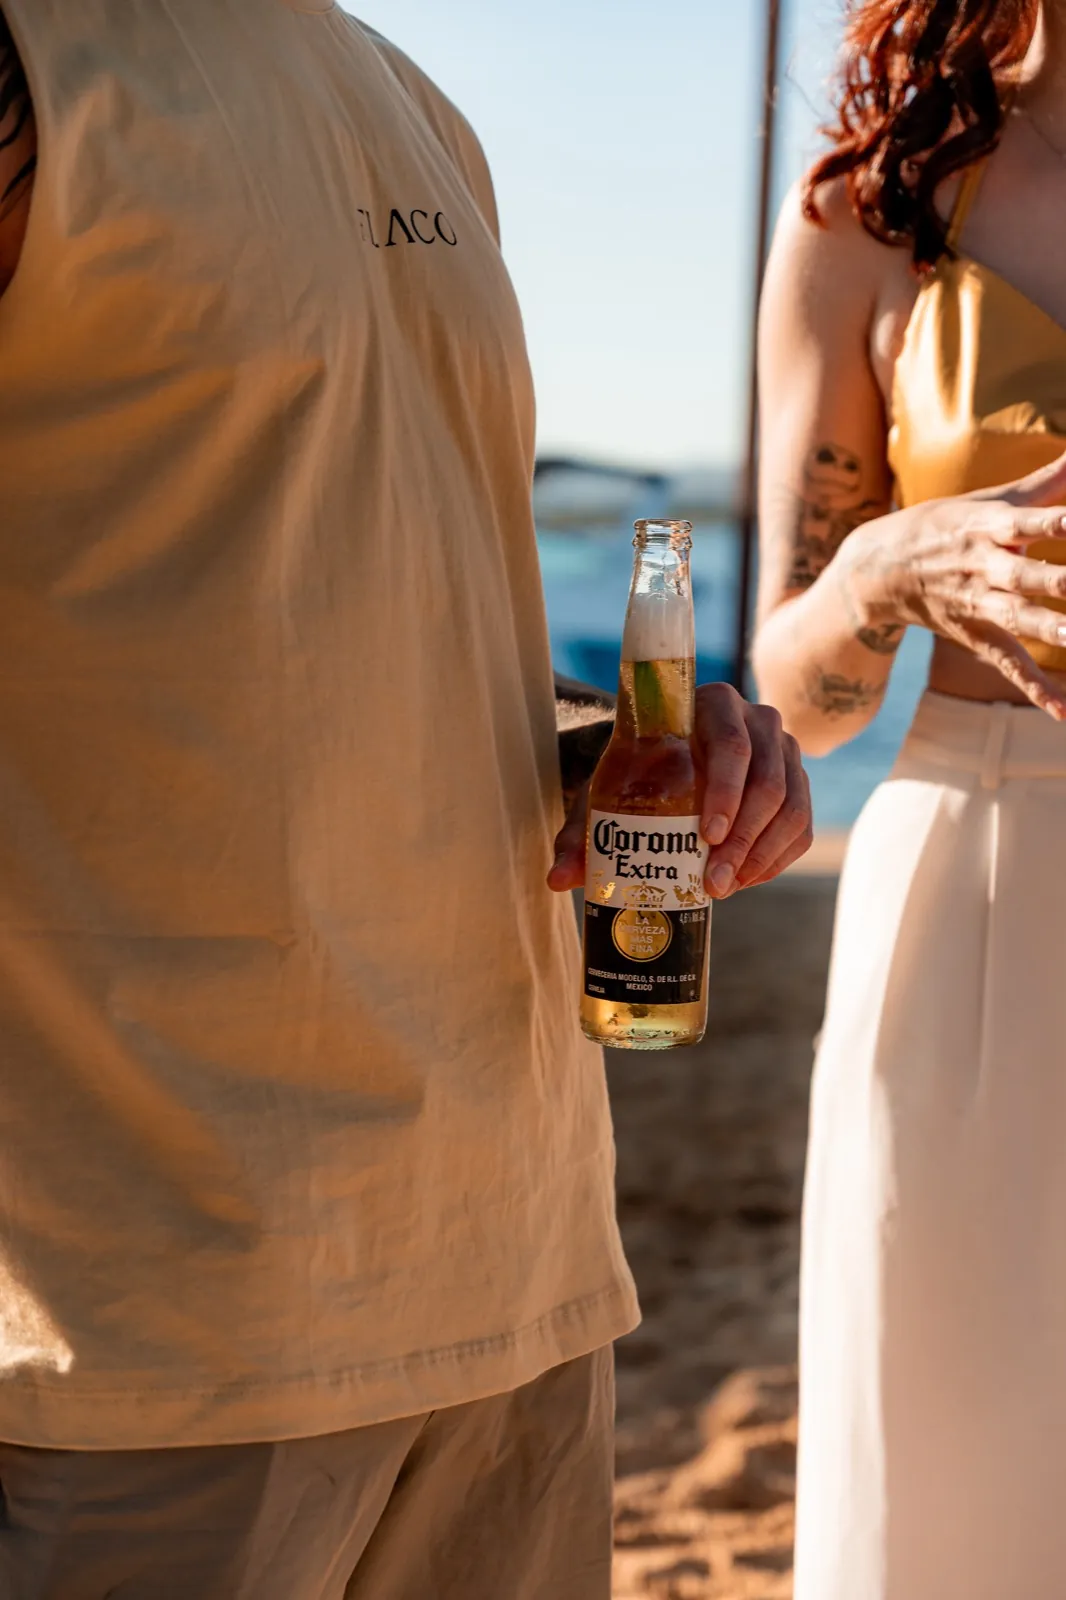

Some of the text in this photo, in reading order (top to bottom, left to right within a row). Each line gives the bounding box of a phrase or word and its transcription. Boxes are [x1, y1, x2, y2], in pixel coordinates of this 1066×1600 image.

[594, 819, 699, 860] Corona
[615, 854, 679, 880] Extra
[635, 917, 650, 925] LA
